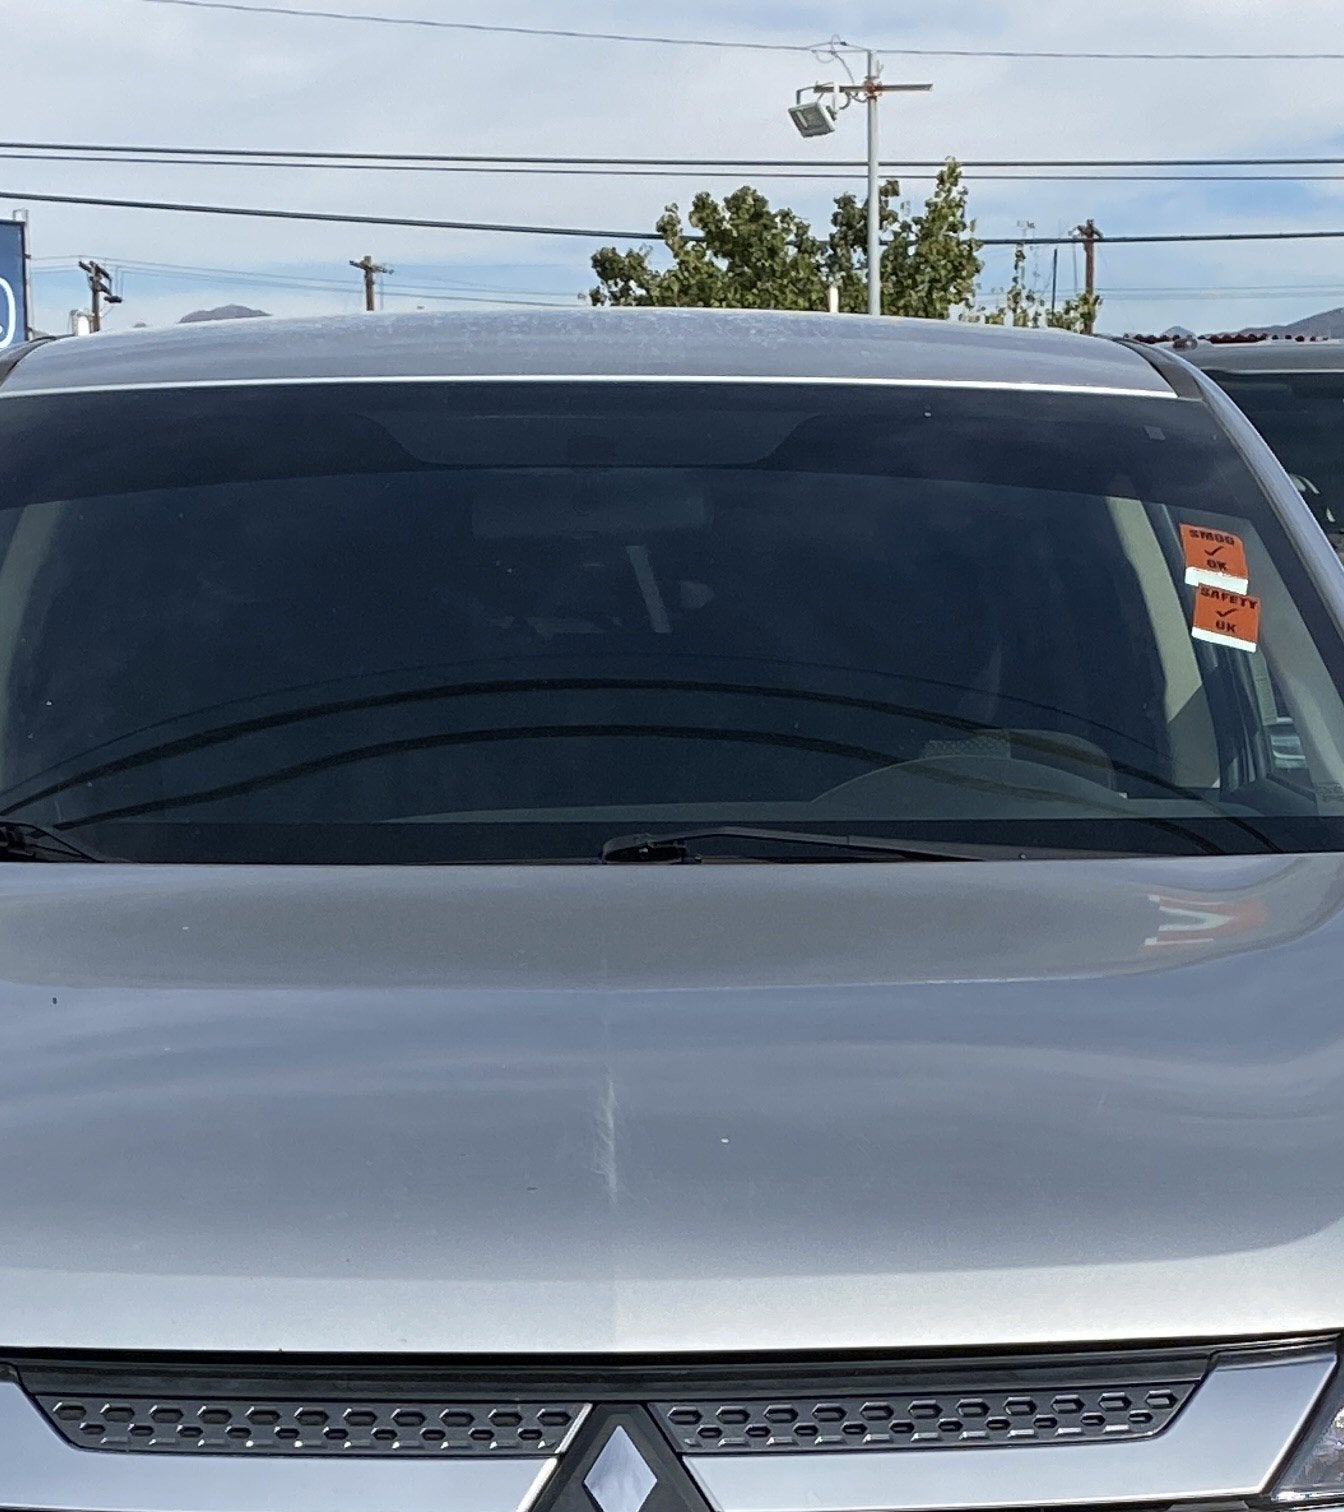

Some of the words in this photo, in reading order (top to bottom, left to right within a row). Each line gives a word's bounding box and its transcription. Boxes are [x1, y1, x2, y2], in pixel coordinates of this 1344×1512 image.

[1189, 529, 1235, 545] SMOG
[1207, 559, 1227, 571] OK
[1200, 587, 1258, 609] SAFETY
[1215, 620, 1236, 633] OK
